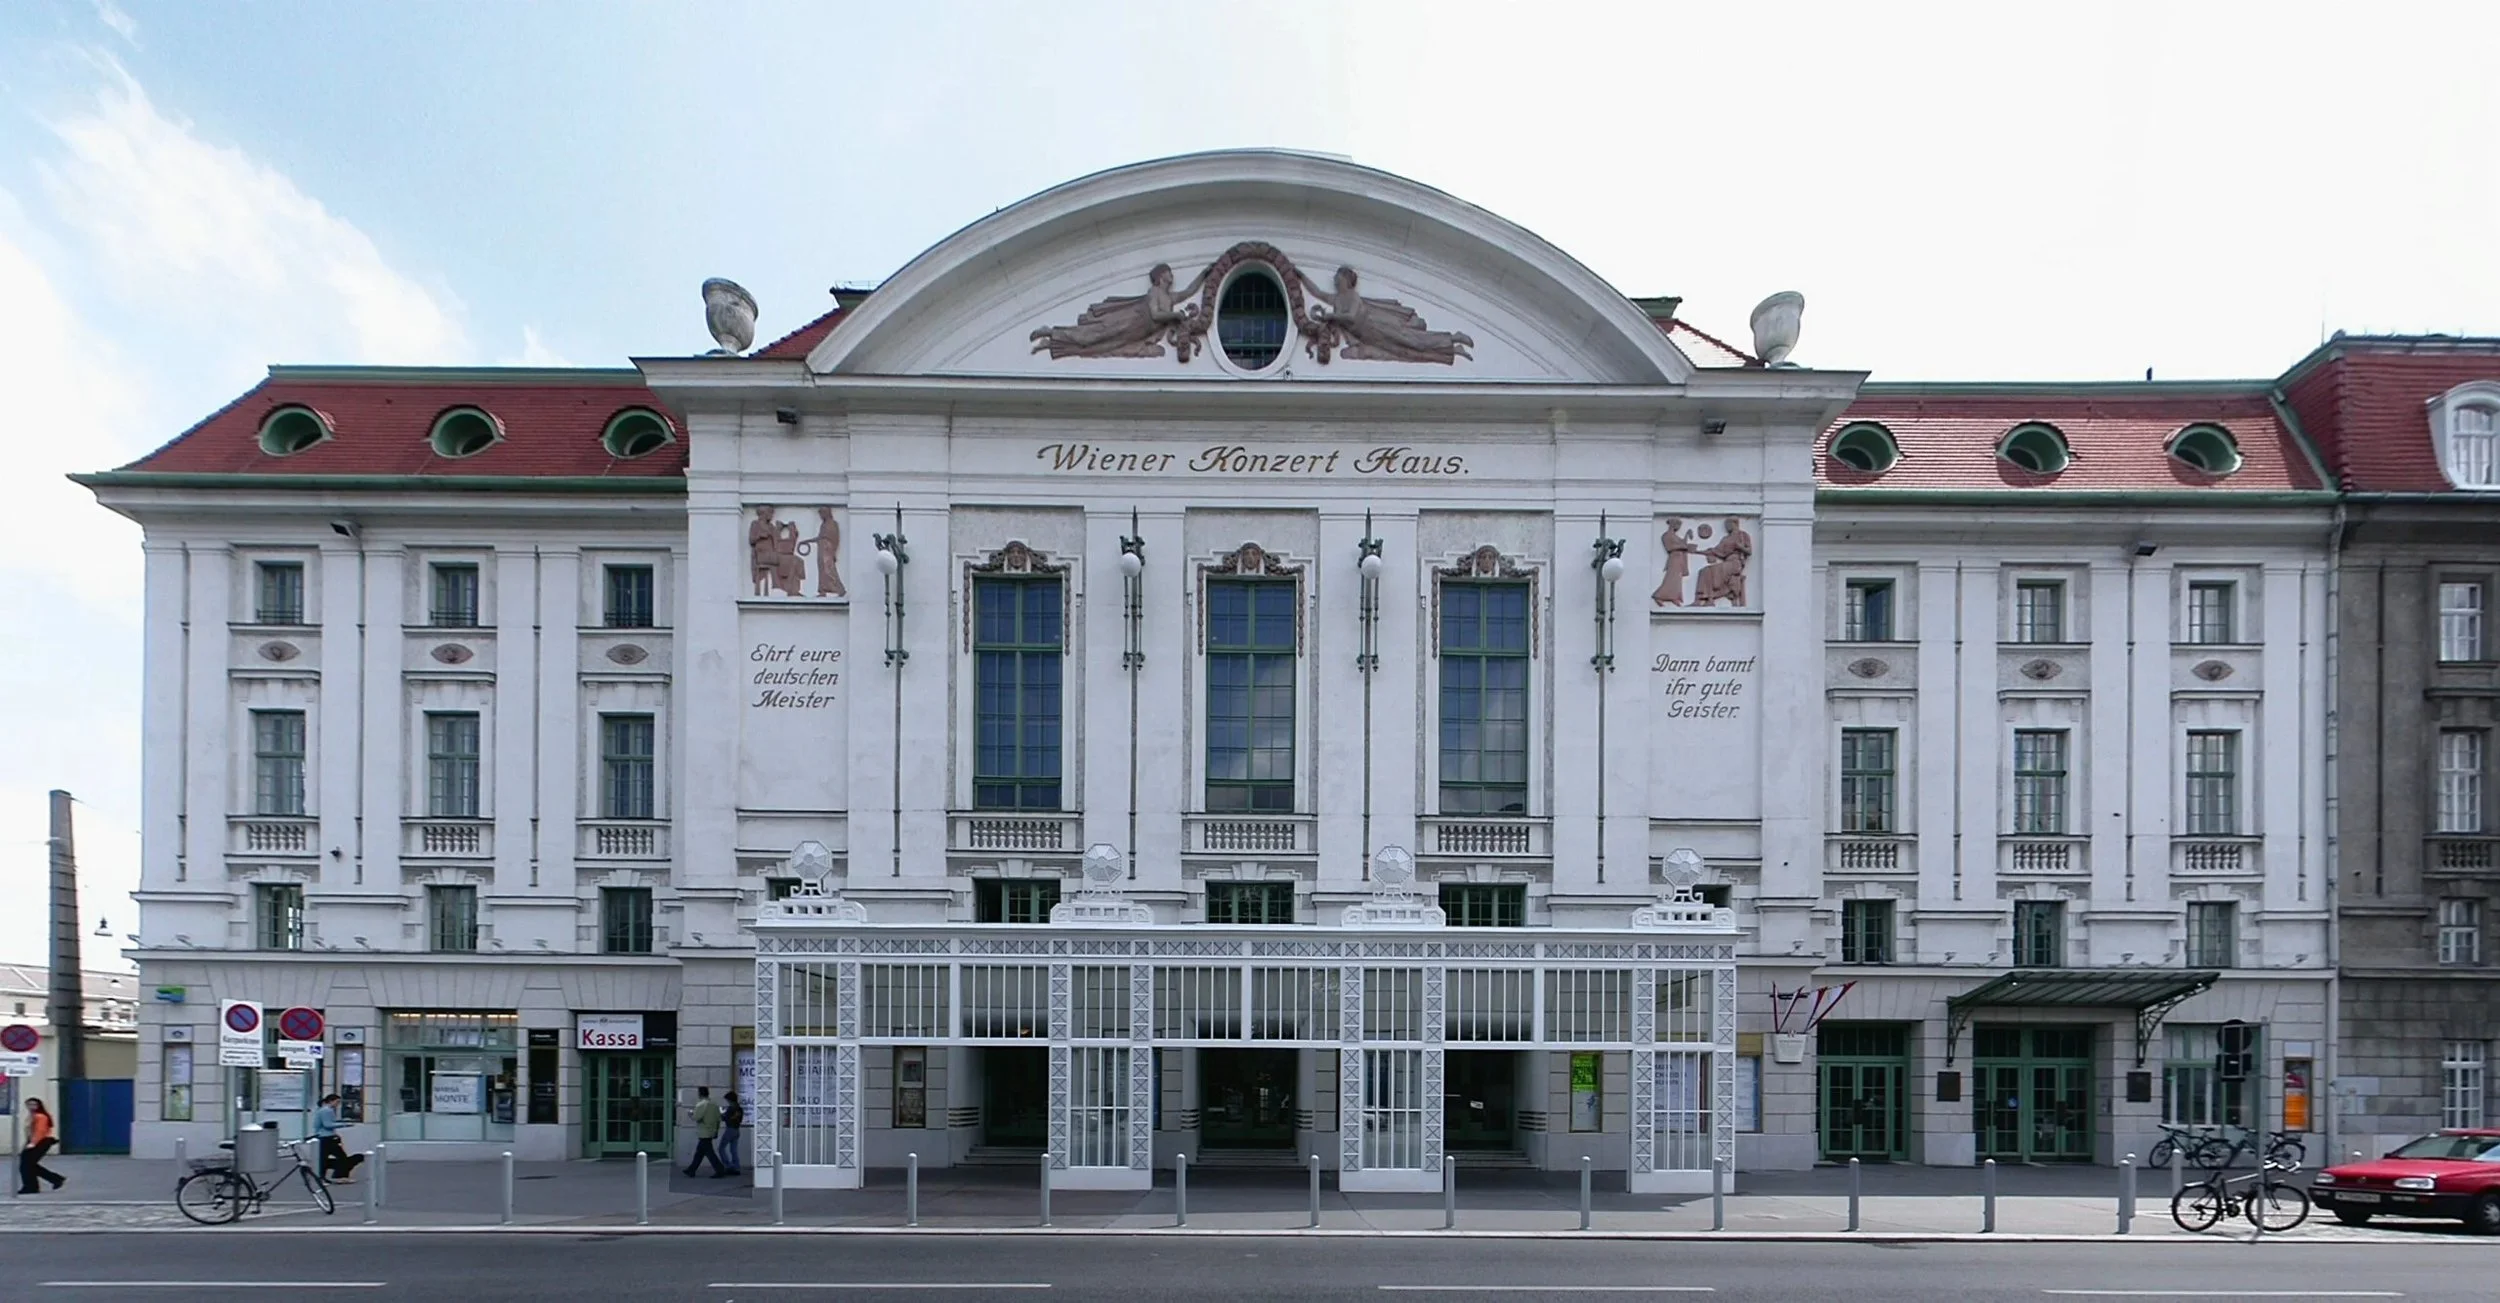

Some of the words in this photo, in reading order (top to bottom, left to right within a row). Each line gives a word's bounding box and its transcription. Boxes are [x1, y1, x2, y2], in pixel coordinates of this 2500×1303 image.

[1036, 443, 1175, 472] Wiener
[1188, 445, 1340, 474] Konzert
[1353, 446, 1470, 475] Haus.
[750, 642, 796, 662] Ehrt
[800, 649, 841, 662] eure
[1651, 653, 1700, 673] Dann
[1705, 655, 1757, 673] bannt
[753, 667, 839, 686] deutschen
[752, 689, 835, 709] Meister
[1665, 677, 1696, 696] ihr
[1699, 678, 1743, 701] gute
[1667, 699, 1740, 719] Geister.
[582, 1028, 638, 1046] Kassa
